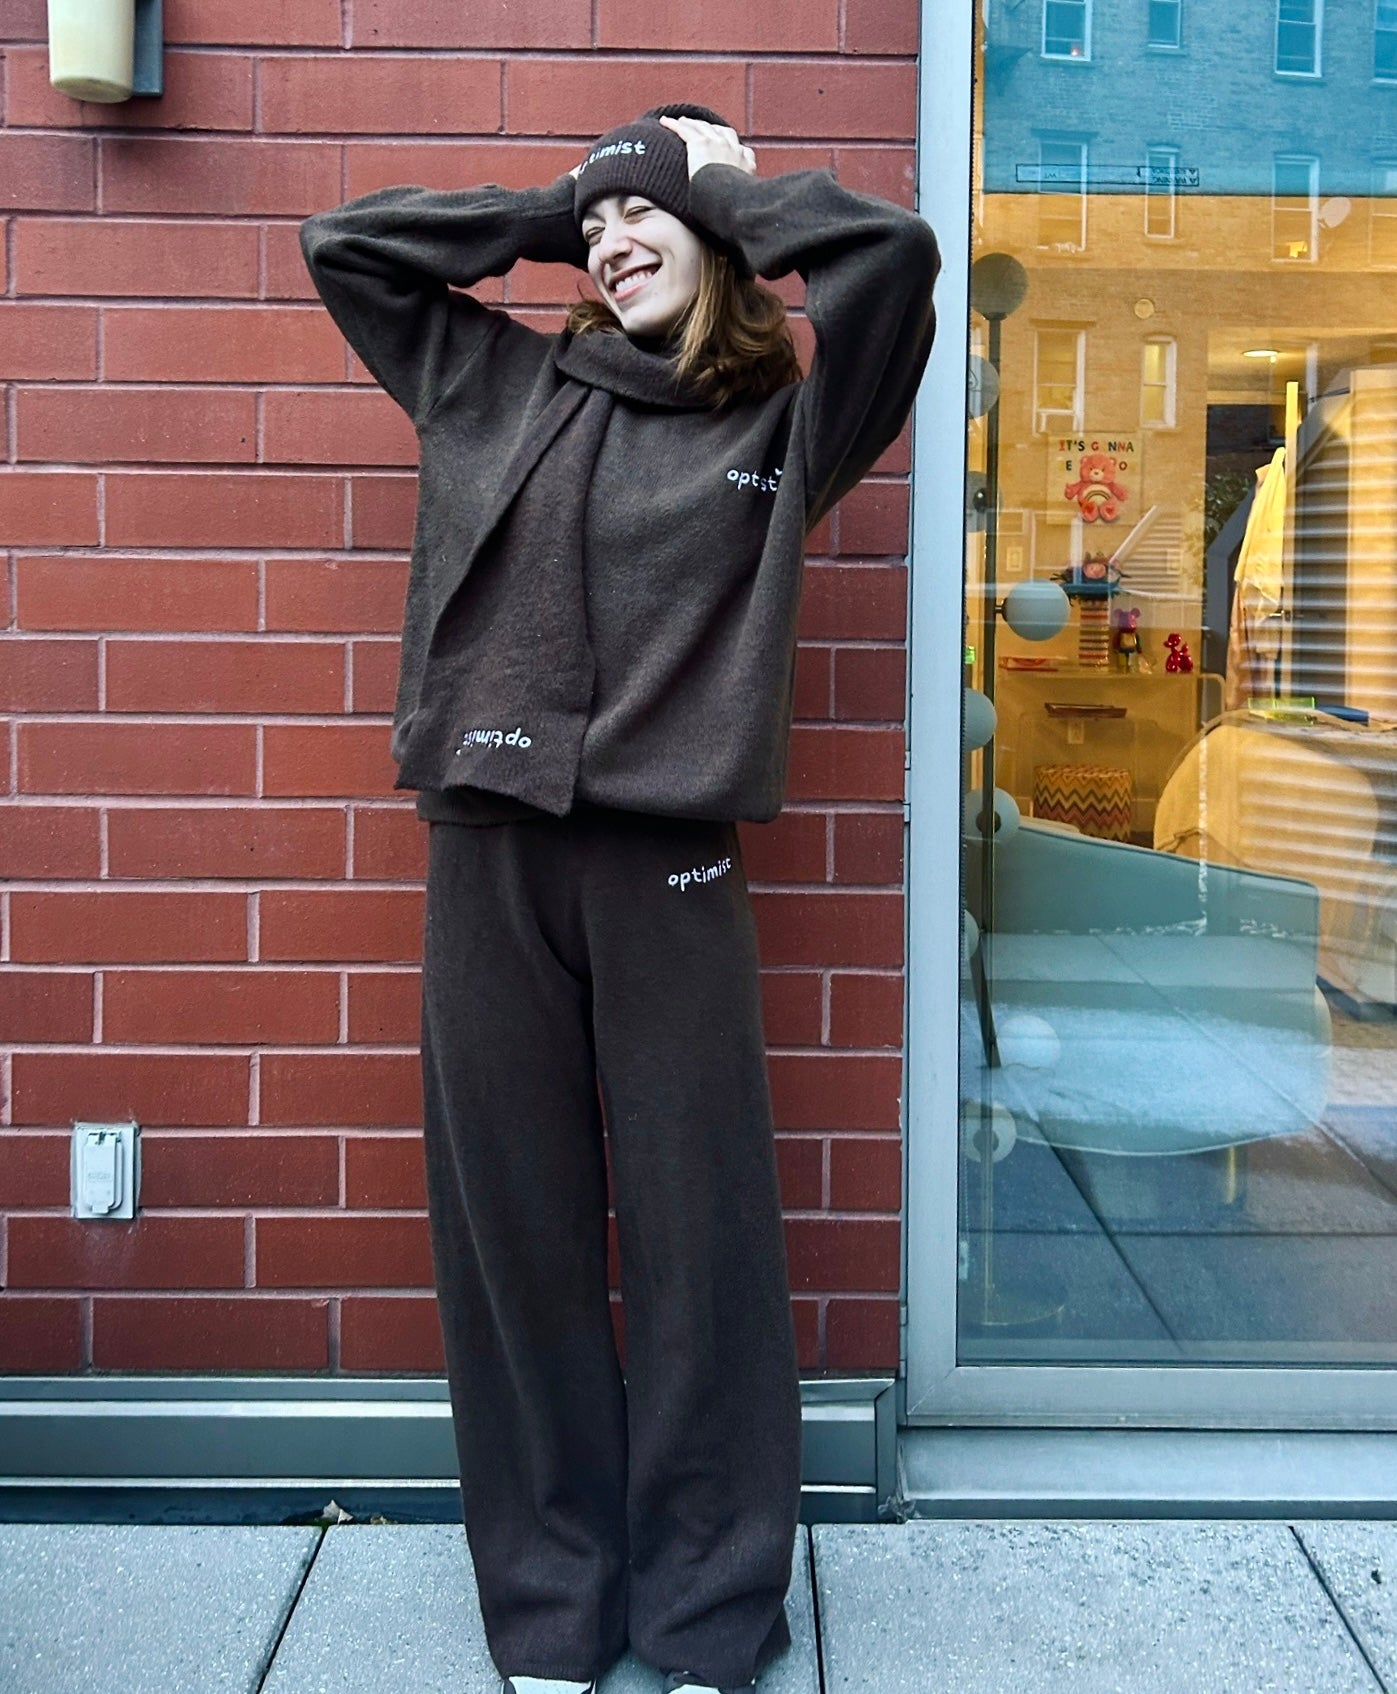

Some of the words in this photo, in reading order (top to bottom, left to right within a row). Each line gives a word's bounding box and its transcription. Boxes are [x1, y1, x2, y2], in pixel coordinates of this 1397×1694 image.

[1059, 440, 1086, 452] IT'S
[1091, 441, 1134, 452] GNNA
[668, 857, 732, 892] optimist
